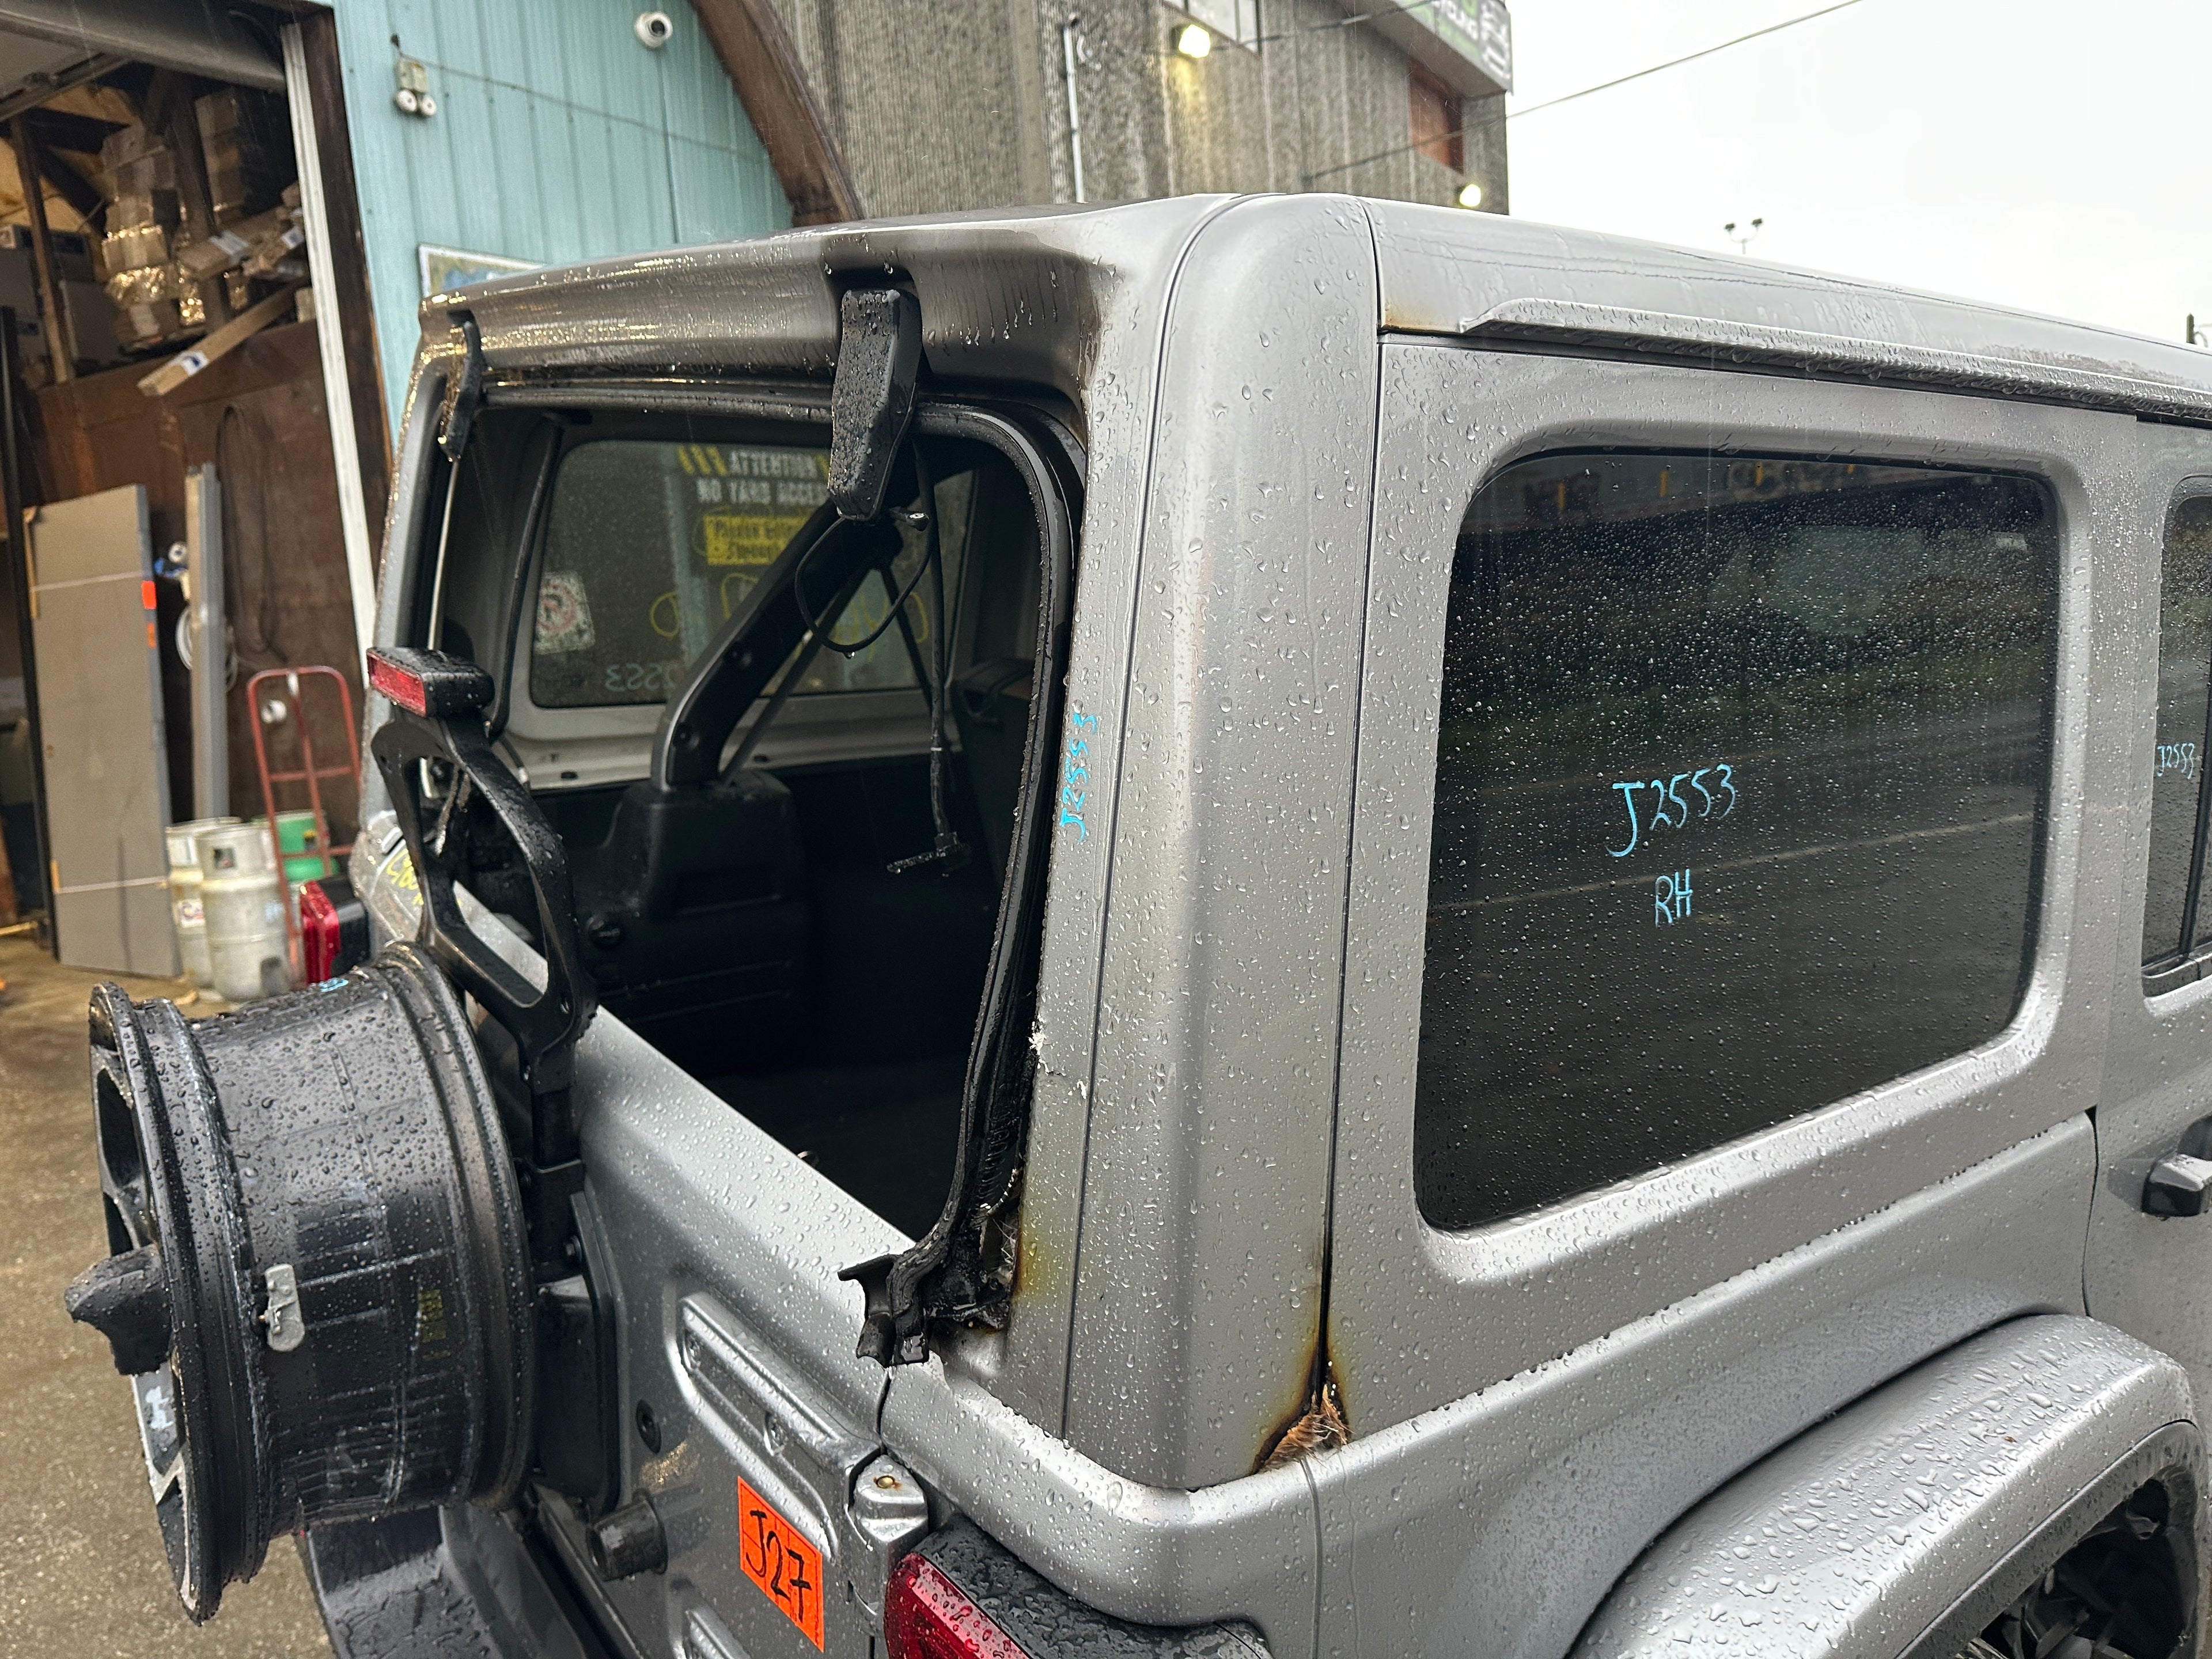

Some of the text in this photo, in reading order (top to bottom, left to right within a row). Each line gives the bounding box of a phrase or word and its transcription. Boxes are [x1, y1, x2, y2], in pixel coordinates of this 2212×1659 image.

[729, 449, 818, 479] ATTENTION
[696, 477, 830, 506] NO YARD ACCES
[2157, 742, 2195, 779] J2553
[1605, 763, 1736, 858] J2553
[1654, 868, 1693, 927] RH
[745, 1509, 812, 1623] J27
